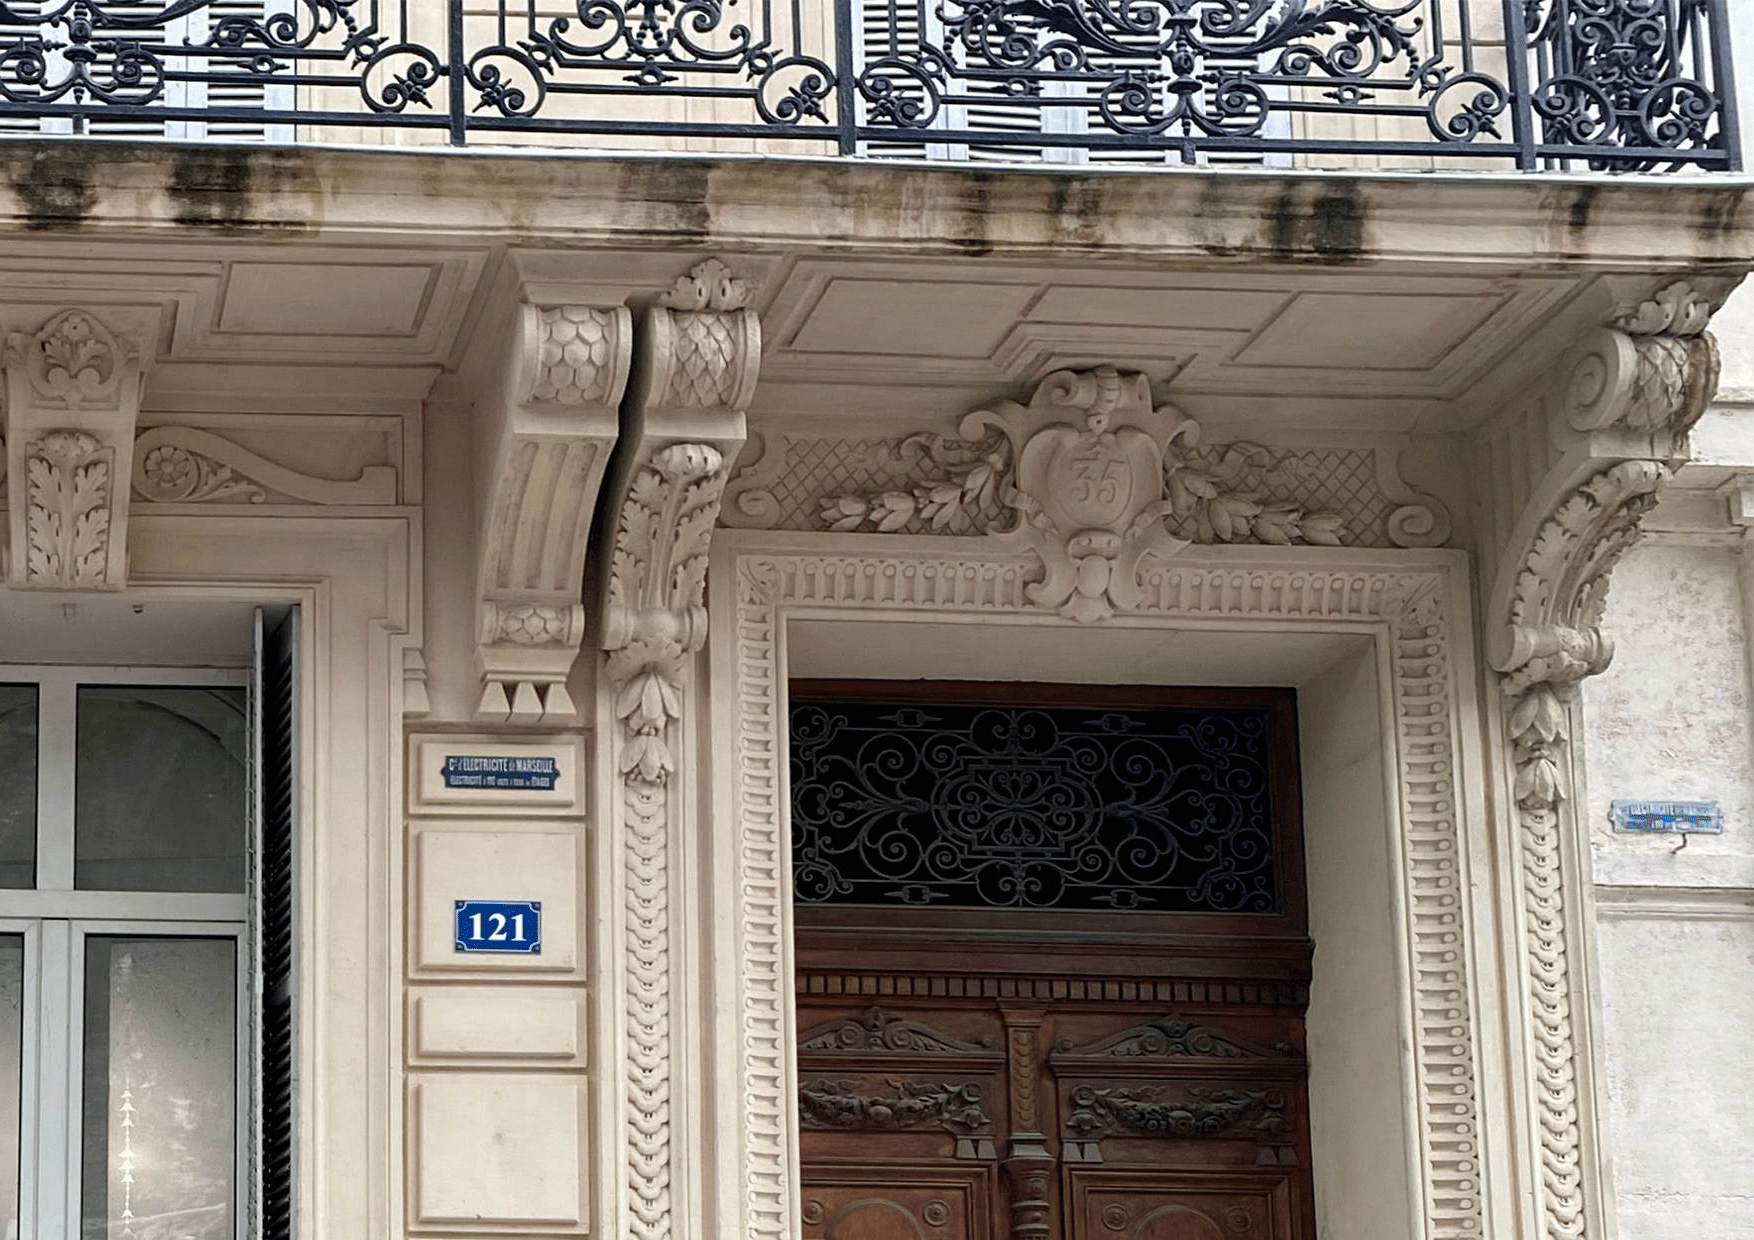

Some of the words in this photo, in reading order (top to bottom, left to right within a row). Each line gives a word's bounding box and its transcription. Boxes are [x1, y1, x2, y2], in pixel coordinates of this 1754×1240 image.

[1069, 457, 1125, 504] 35
[516, 759, 553, 772] MARSEILLE
[468, 912, 527, 942] 121
